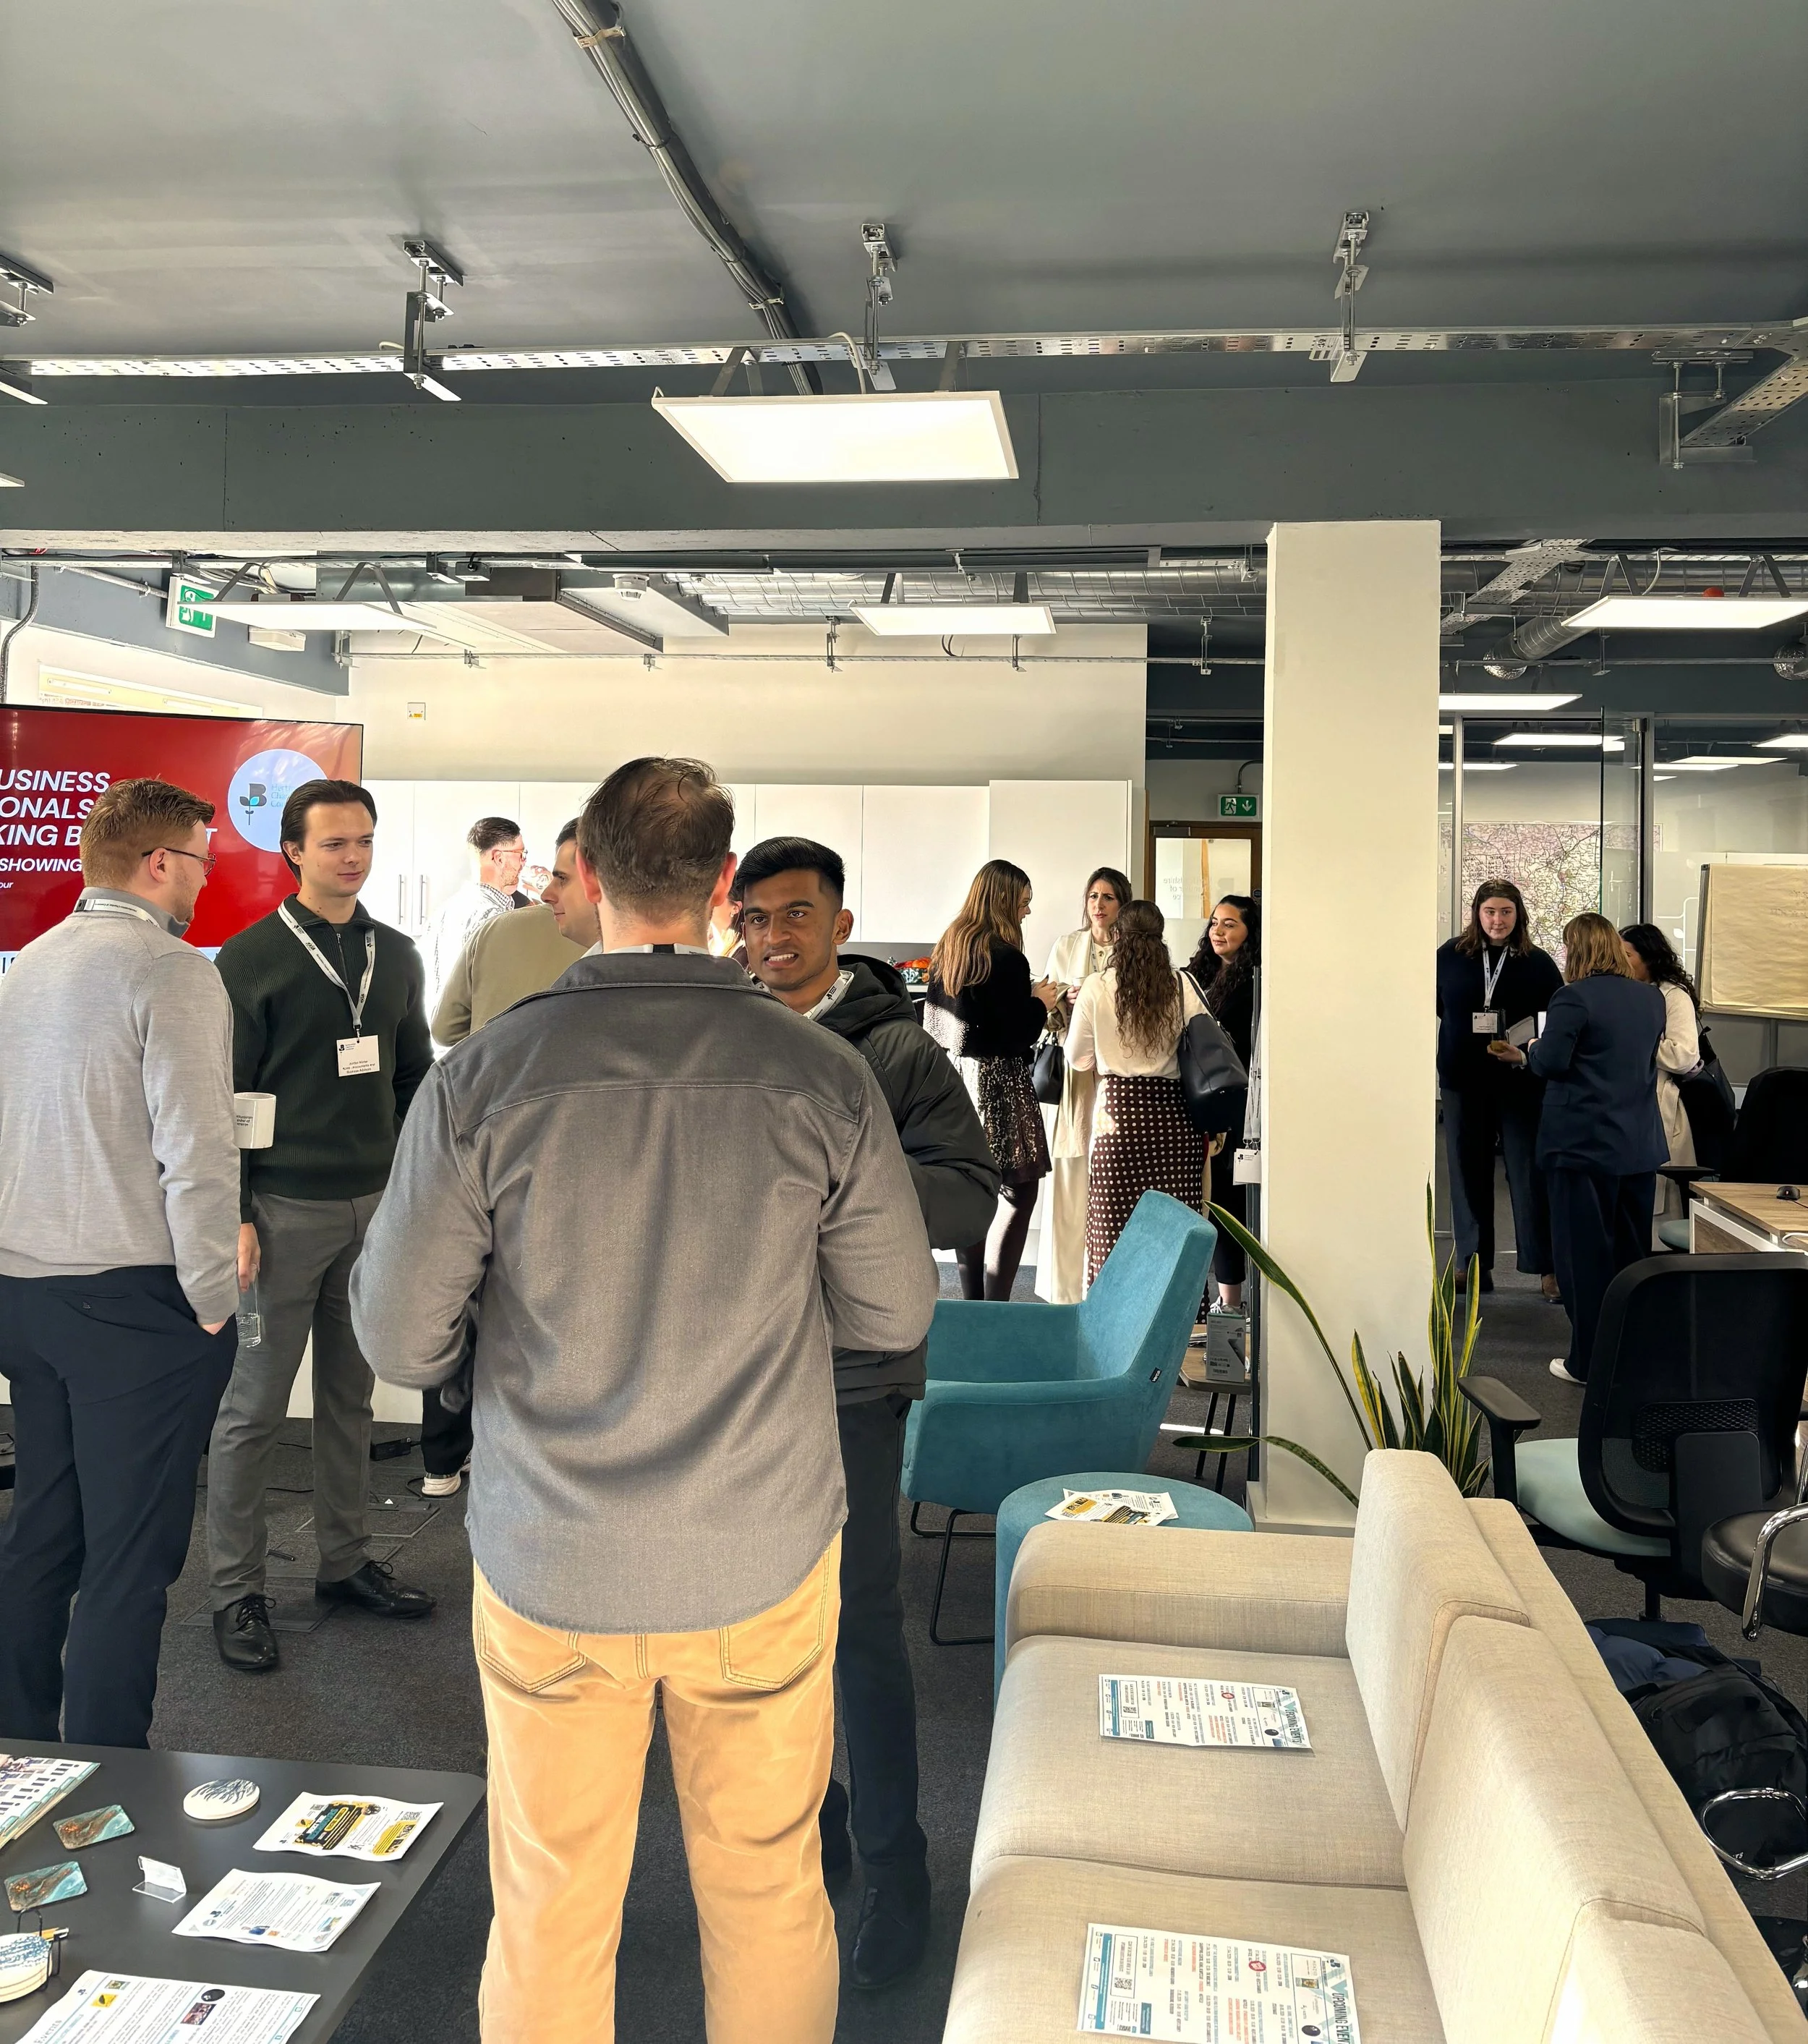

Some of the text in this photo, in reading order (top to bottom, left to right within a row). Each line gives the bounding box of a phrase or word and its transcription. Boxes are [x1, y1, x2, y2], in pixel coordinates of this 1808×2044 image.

[0, 769, 111, 793] USINESS
[0, 796, 95, 819] ONALS
[0, 857, 82, 872] SHOWING
[1289, 1727, 1302, 1743] EVENTS
[1332, 1993, 1348, 2024] UPCOMING
